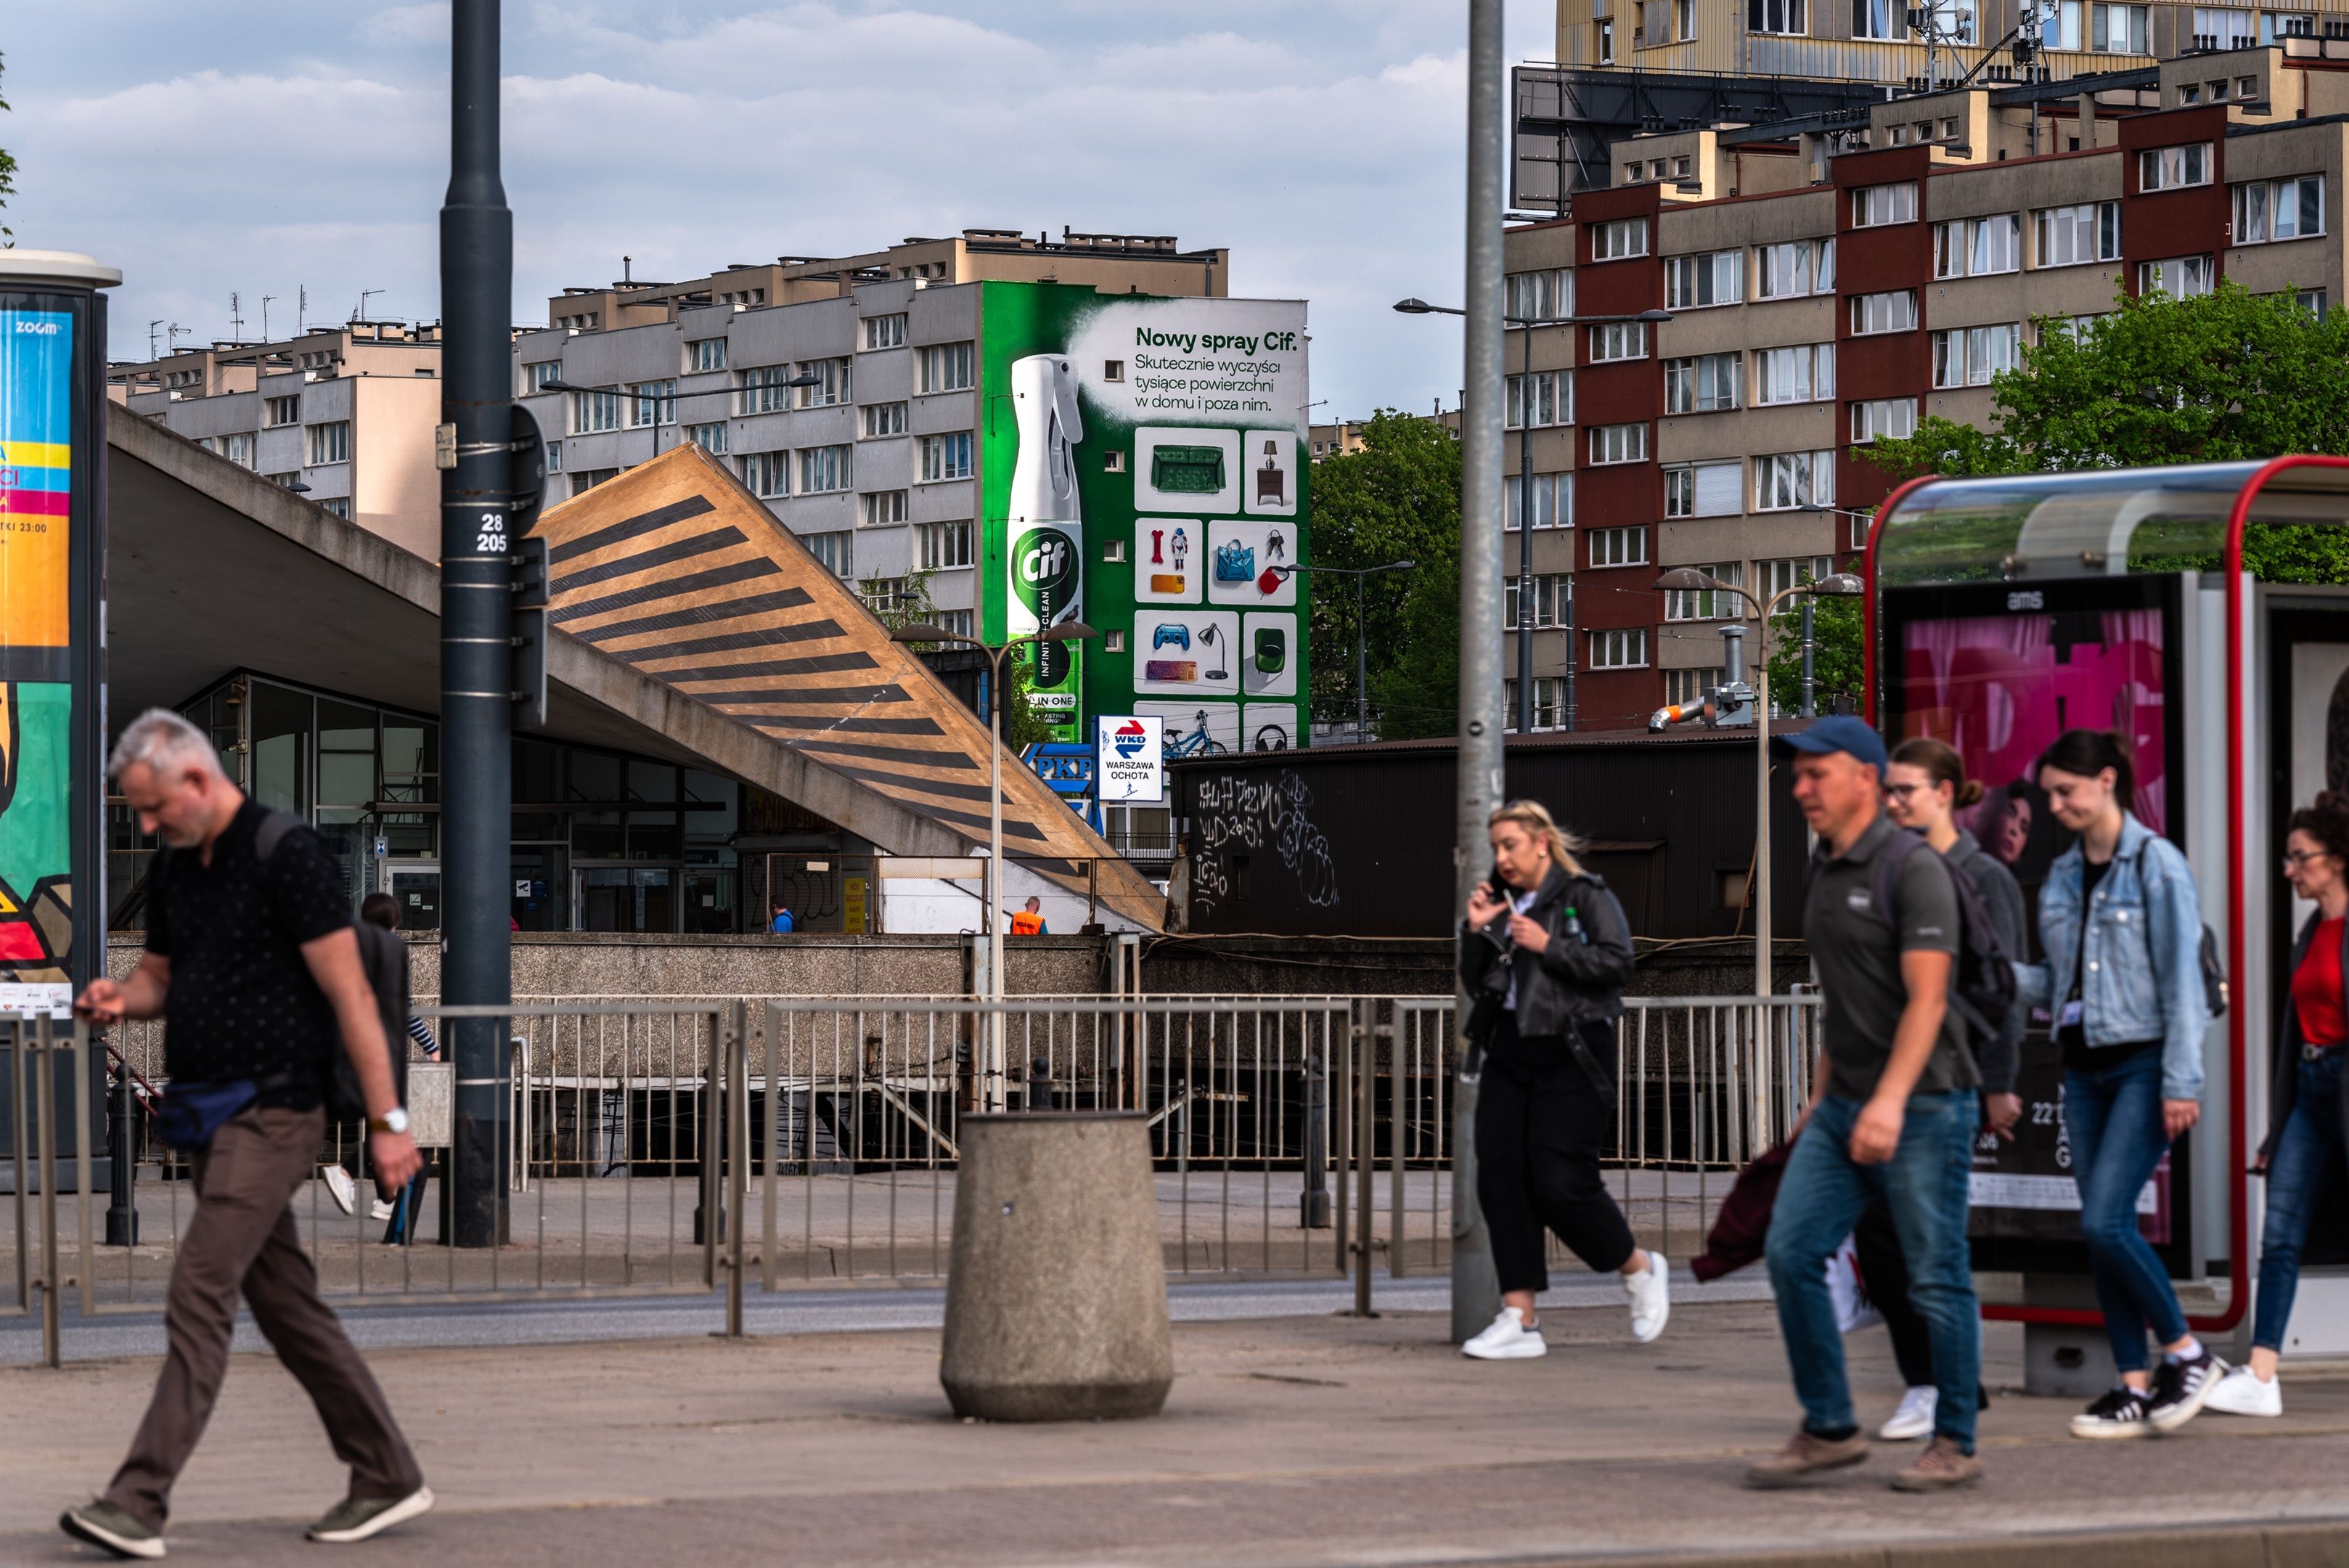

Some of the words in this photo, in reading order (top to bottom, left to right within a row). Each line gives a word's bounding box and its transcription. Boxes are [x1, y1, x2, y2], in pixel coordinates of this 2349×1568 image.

[16, 321, 57, 335] zoom
[1136, 327, 1197, 354] Nowy
[1201, 333, 1259, 356] spray
[1264, 331, 1297, 351] Cif.
[1135, 354, 1214, 371] Skutecznie
[1217, 359, 1280, 377] wyczyści
[1135, 375, 1186, 393] tysiące
[1190, 377, 1274, 394] powierzchni
[1135, 397, 1148, 407] w
[1152, 394, 1194, 409] domu
[1198, 396, 1201, 409] i
[1204, 399, 1238, 414] poza
[1242, 397, 1272, 412] nim.
[20, 523, 47, 533] 23:00
[481, 513, 503, 532] 28
[476, 534, 507, 552] 205
[1022, 541, 1065, 582] Cif
[2006, 591, 2044, 611] ams
[1052, 697, 1072, 706] ONE
[1035, 757, 1092, 778] PKP
[1106, 761, 1154, 769] WARSZAWA
[1111, 771, 1149, 780] OCHOTA
